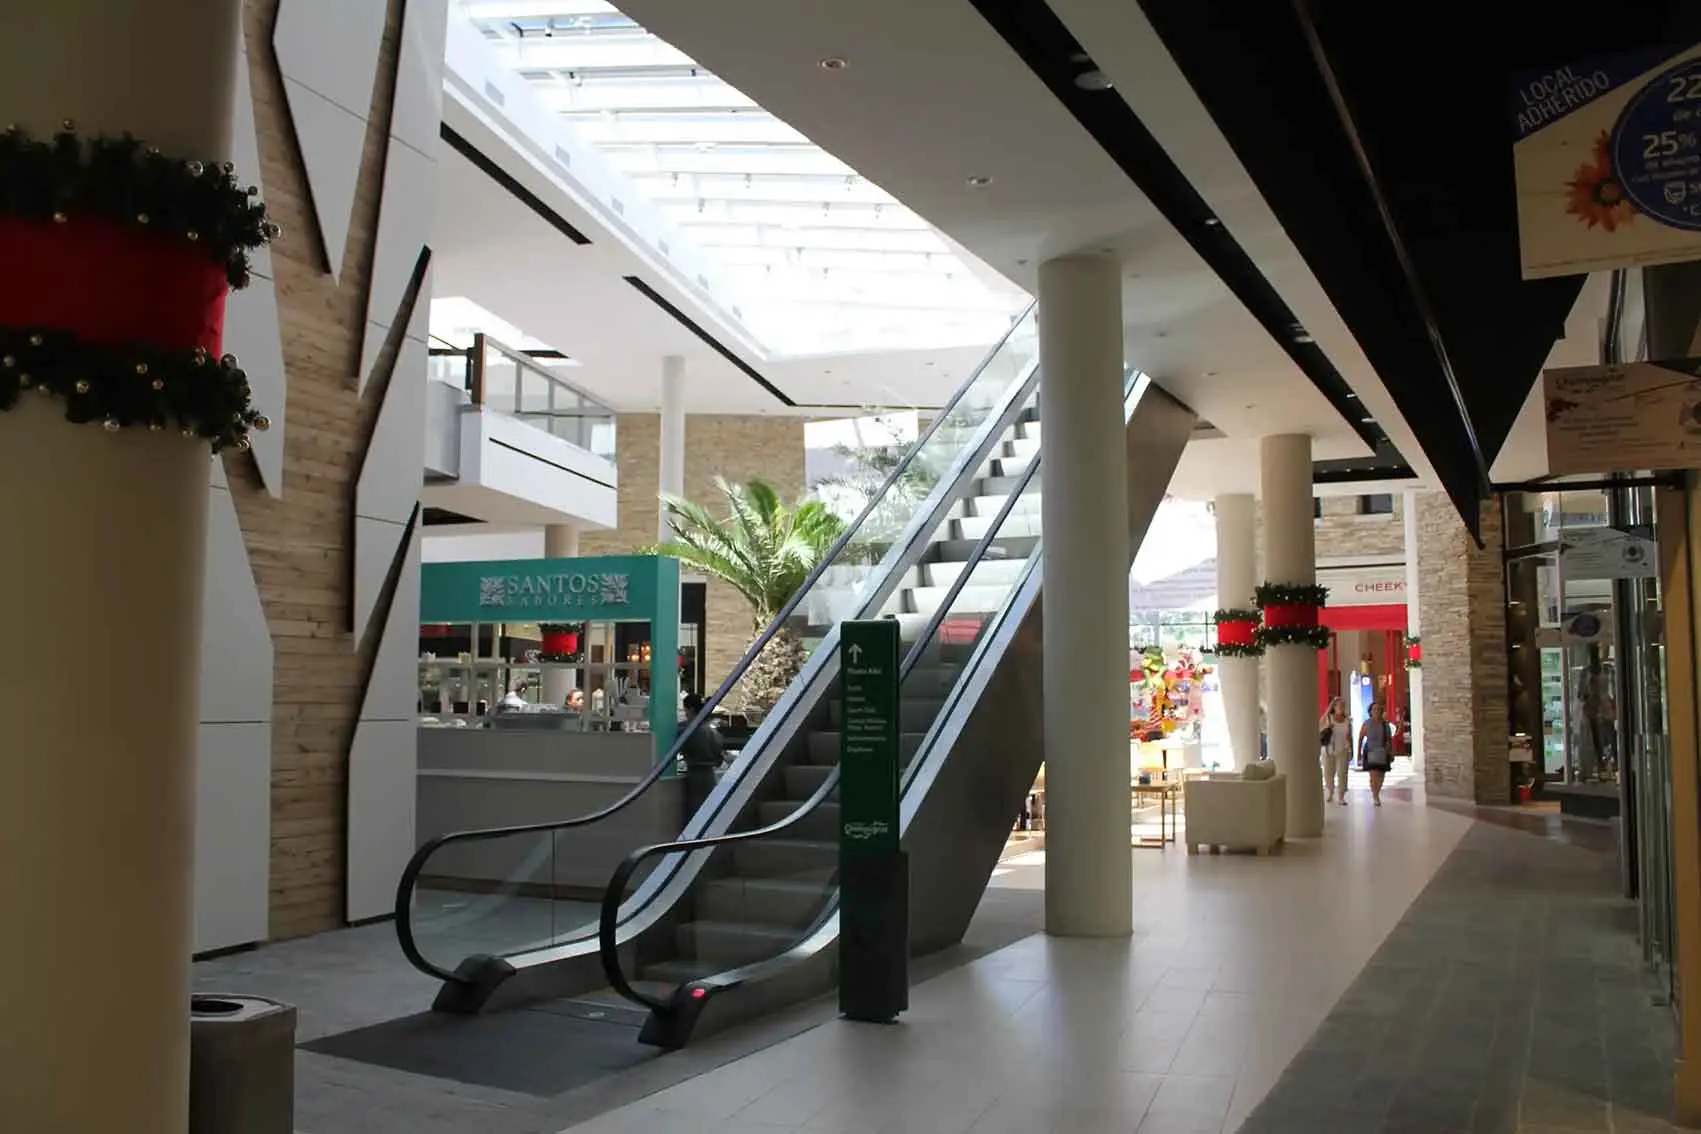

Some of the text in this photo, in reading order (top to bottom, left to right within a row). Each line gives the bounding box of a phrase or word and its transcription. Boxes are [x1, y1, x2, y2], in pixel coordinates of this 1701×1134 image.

[1519, 66, 1582, 106] LOCAL
[1518, 70, 1610, 133] ADHERIDO
[507, 573, 600, 594] SANTOS
[507, 593, 599, 609] SABORES
